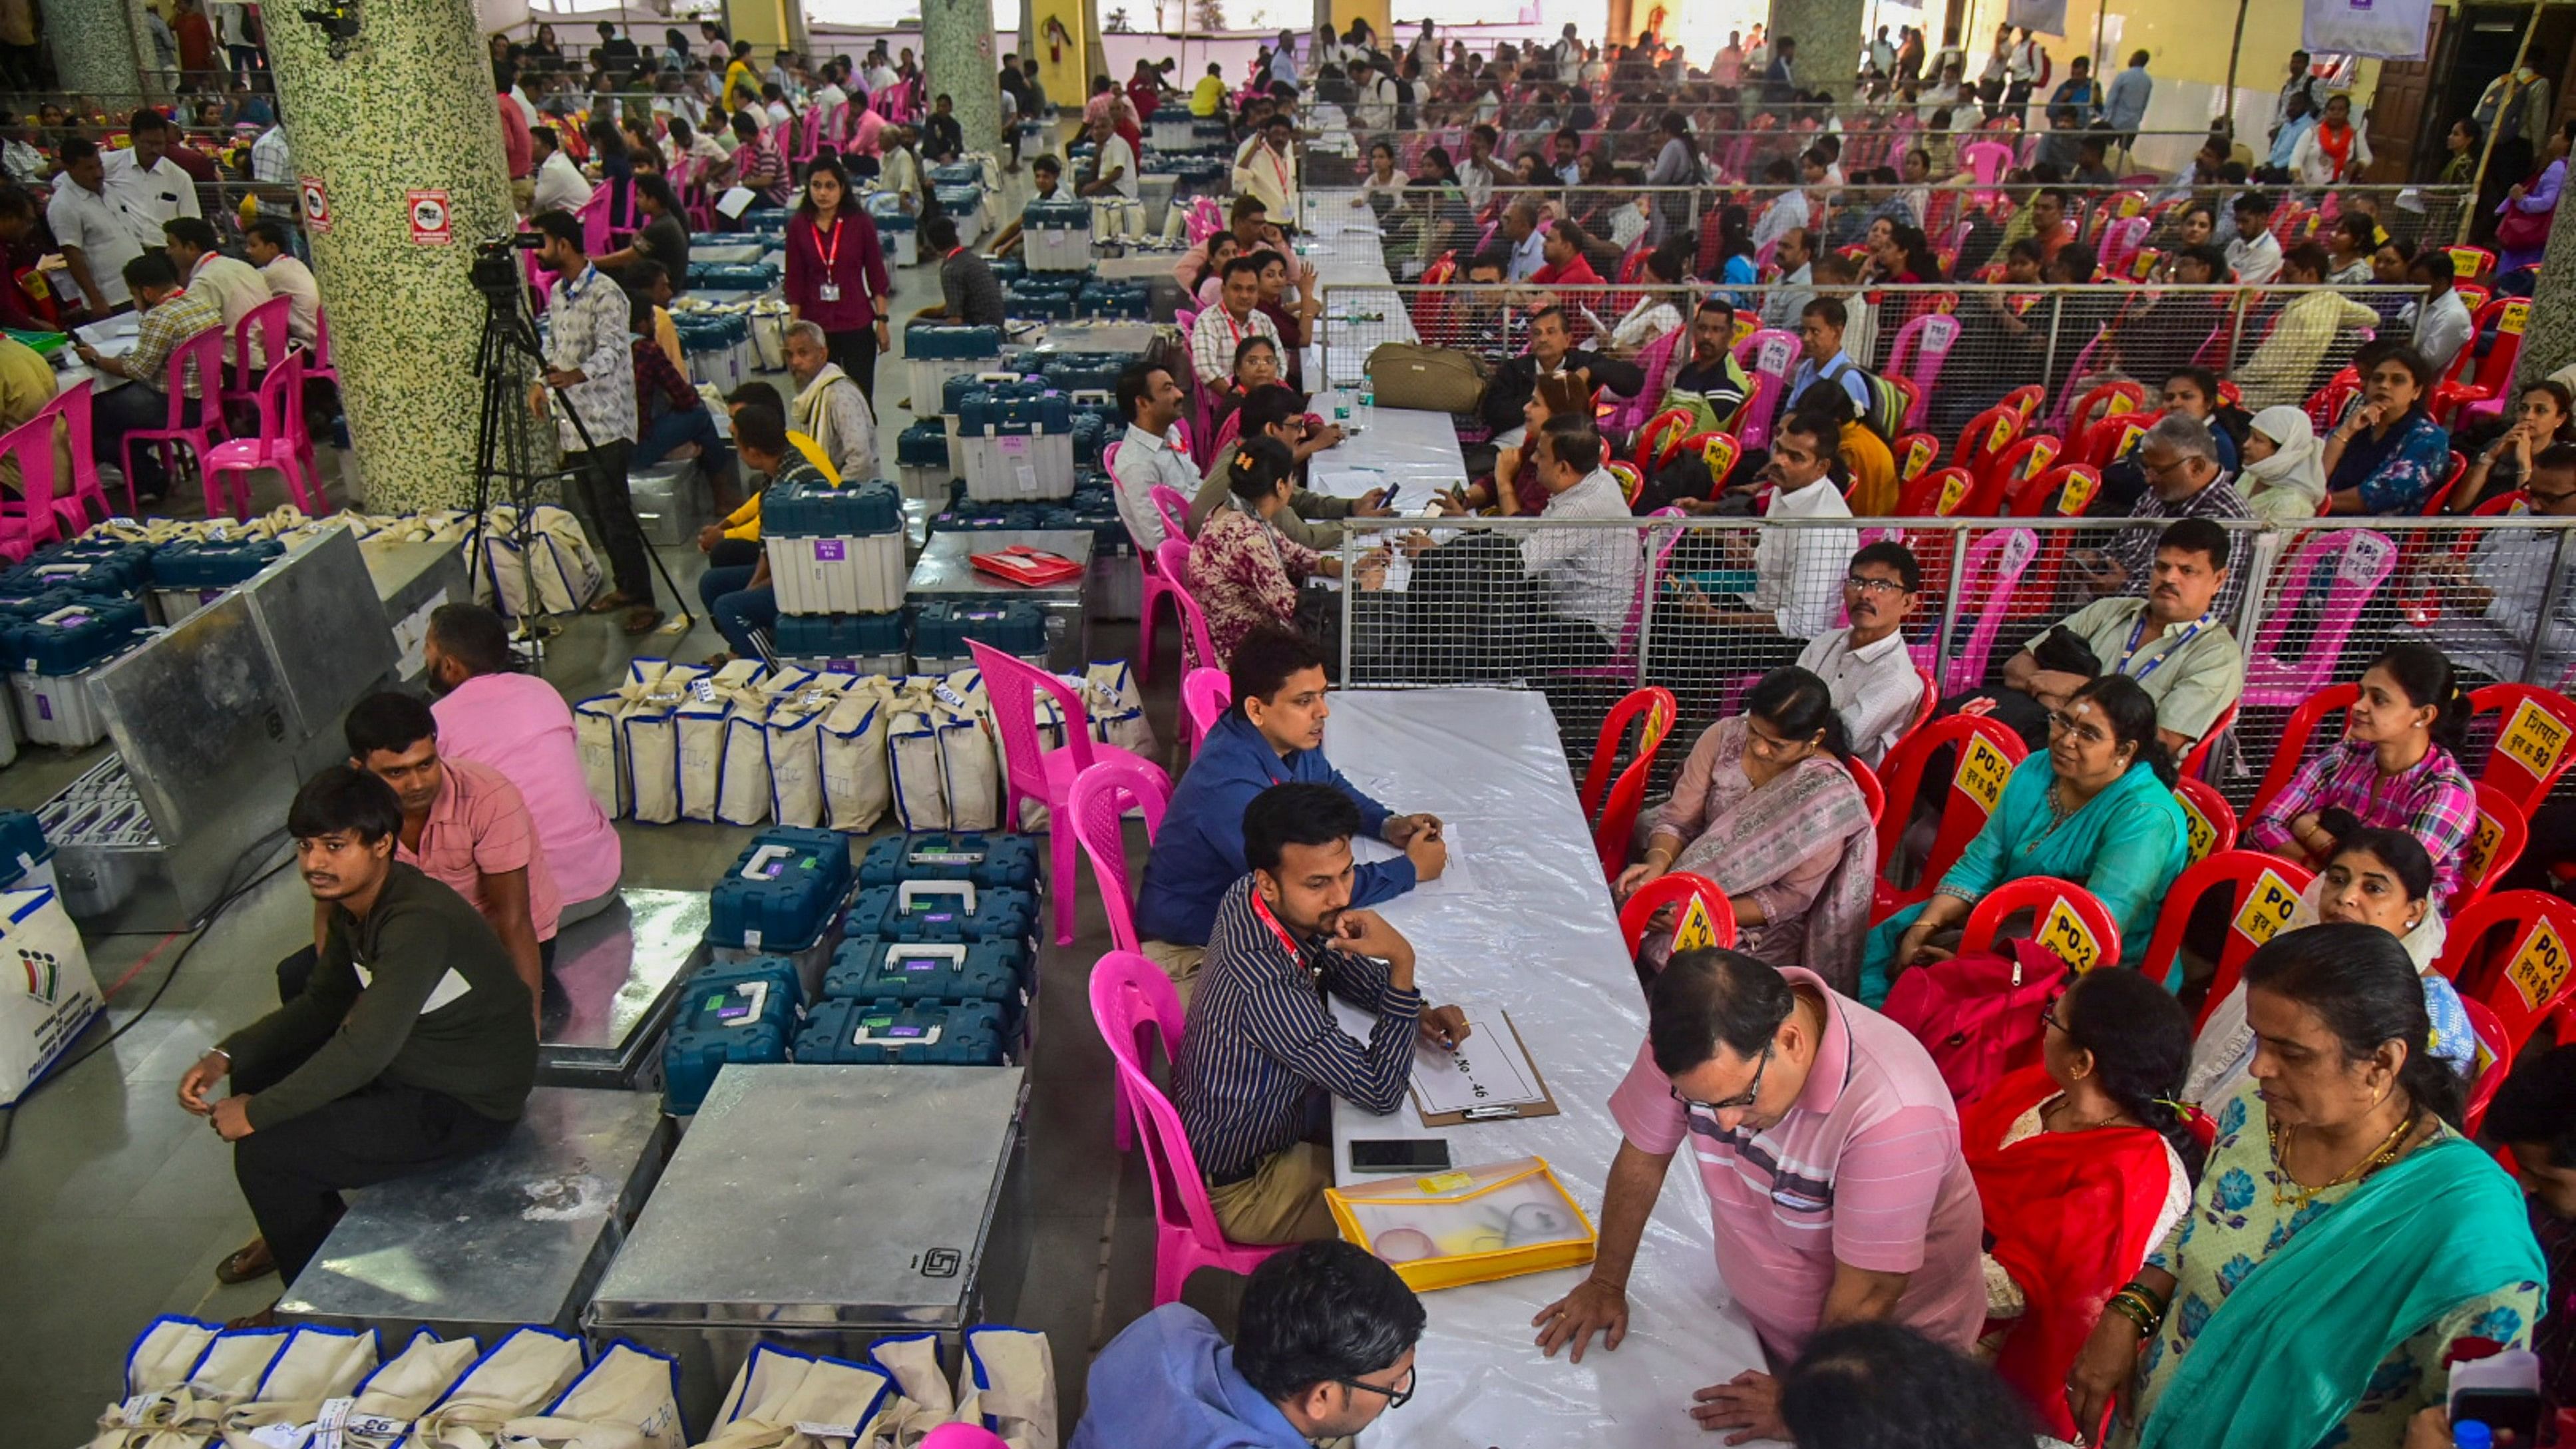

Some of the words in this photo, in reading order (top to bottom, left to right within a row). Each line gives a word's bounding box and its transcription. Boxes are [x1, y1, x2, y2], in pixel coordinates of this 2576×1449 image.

[2533, 746, 2550, 768] 93
[1984, 781, 1998, 803] 90
[2535, 979, 2550, 1008] 92
[1471, 1084, 1489, 1098] 46
